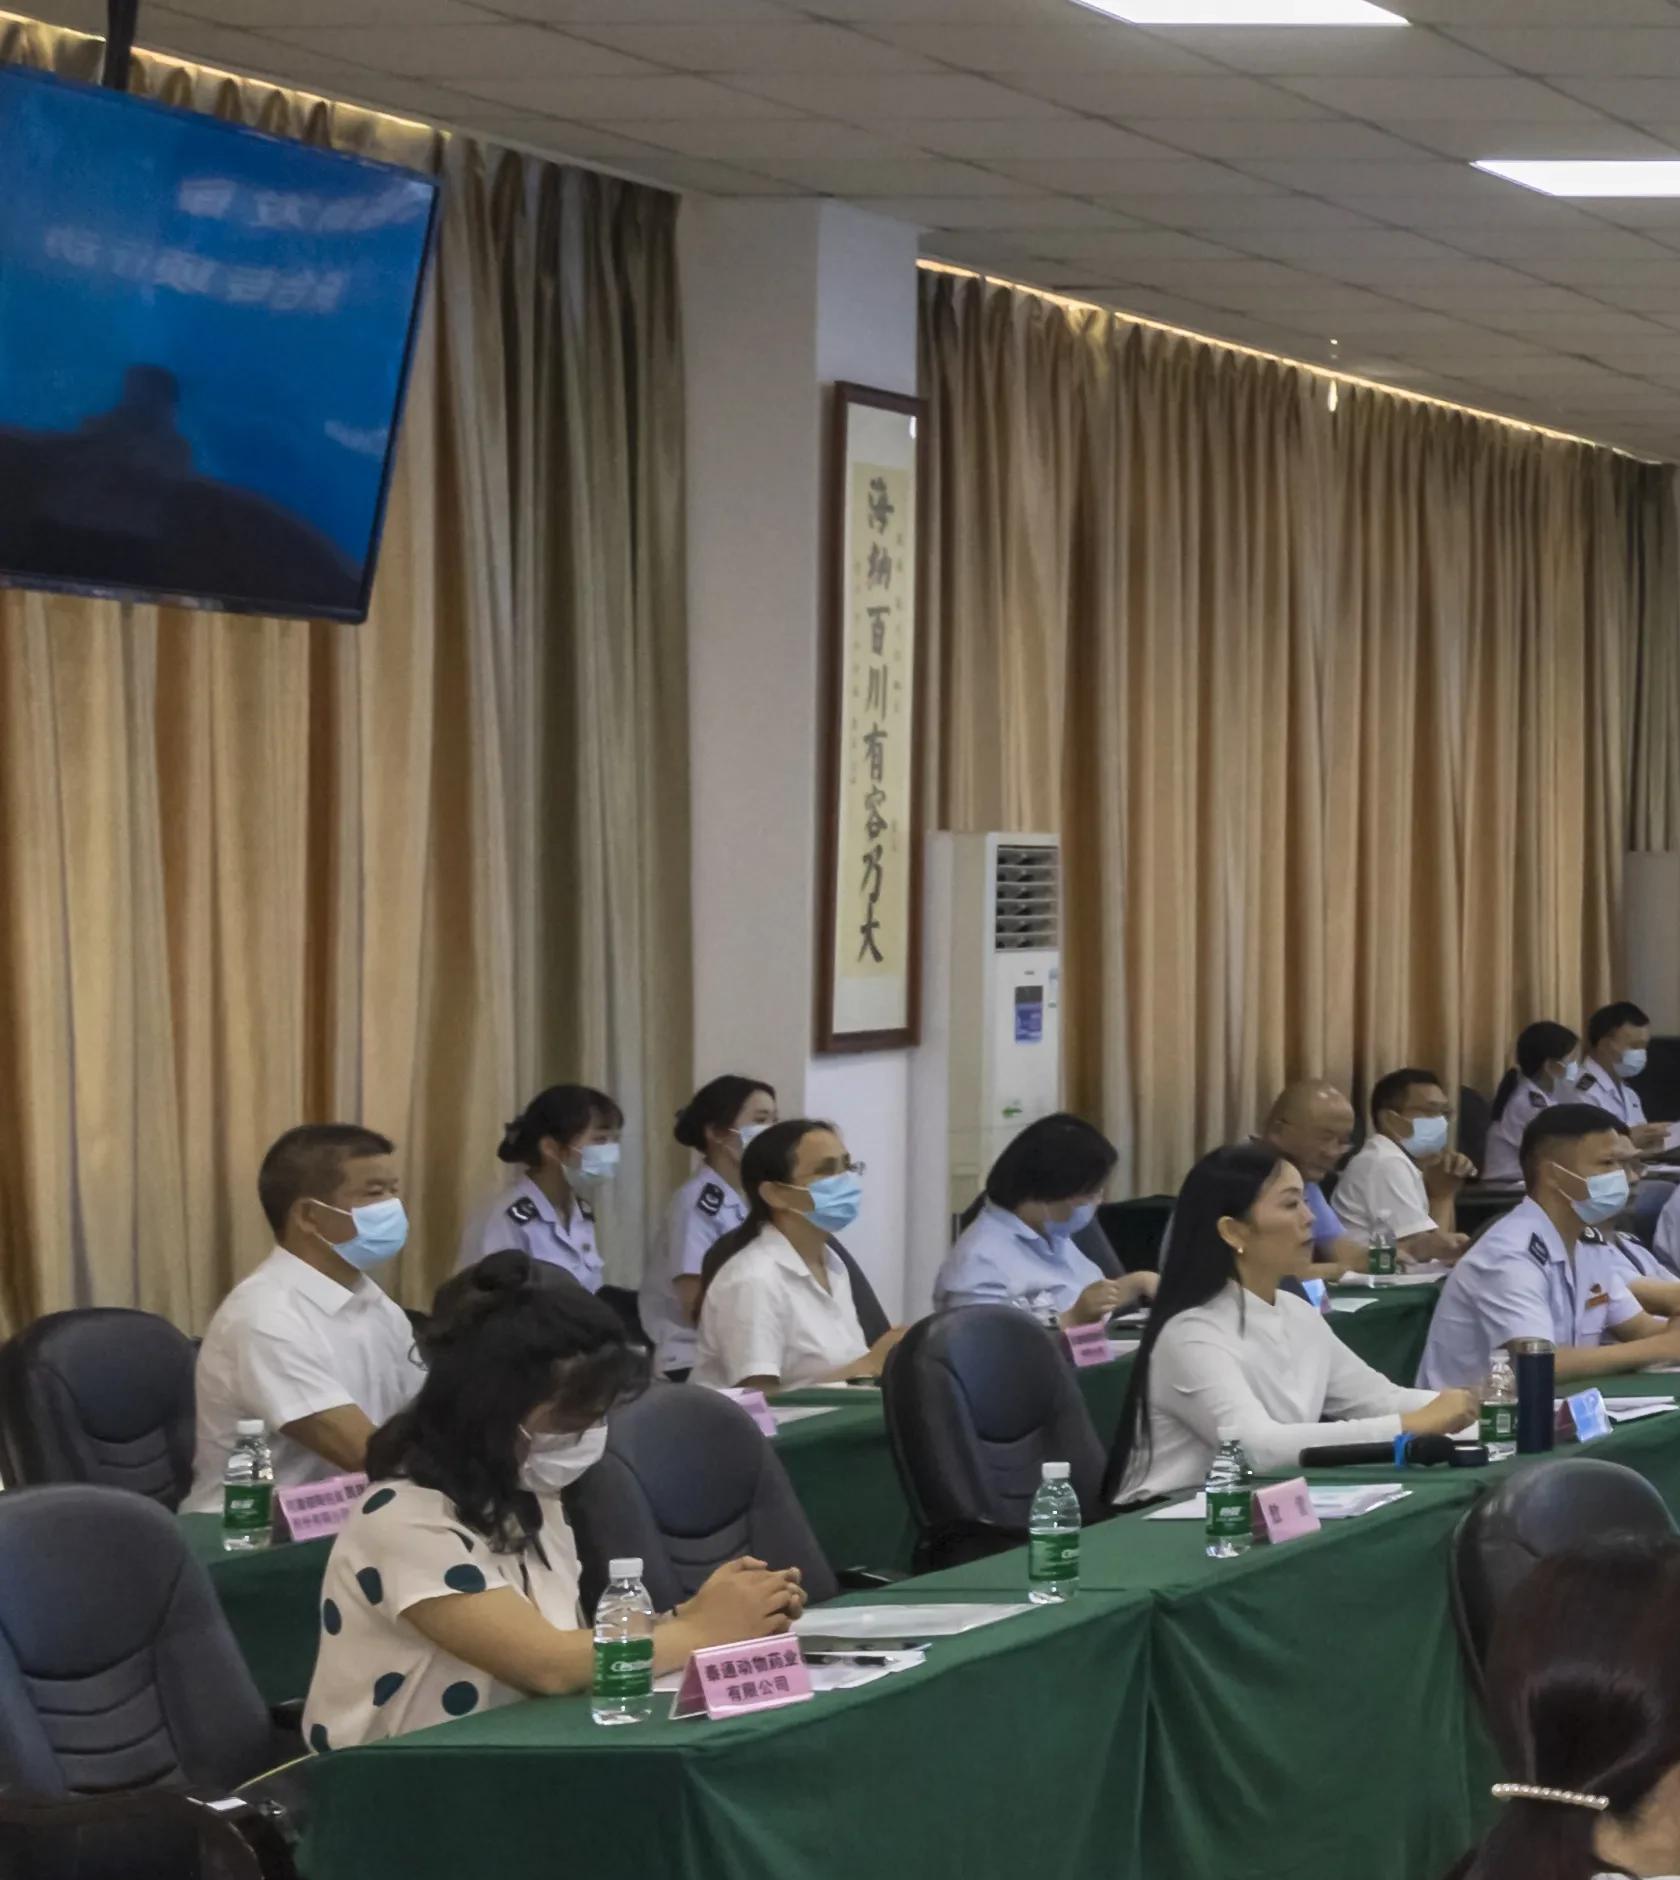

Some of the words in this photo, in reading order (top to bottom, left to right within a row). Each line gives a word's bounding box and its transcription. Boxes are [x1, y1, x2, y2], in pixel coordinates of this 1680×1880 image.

[857, 478, 895, 964] 海纳百川有容乃大
[727, 1675, 790, 1702] 有限公司
